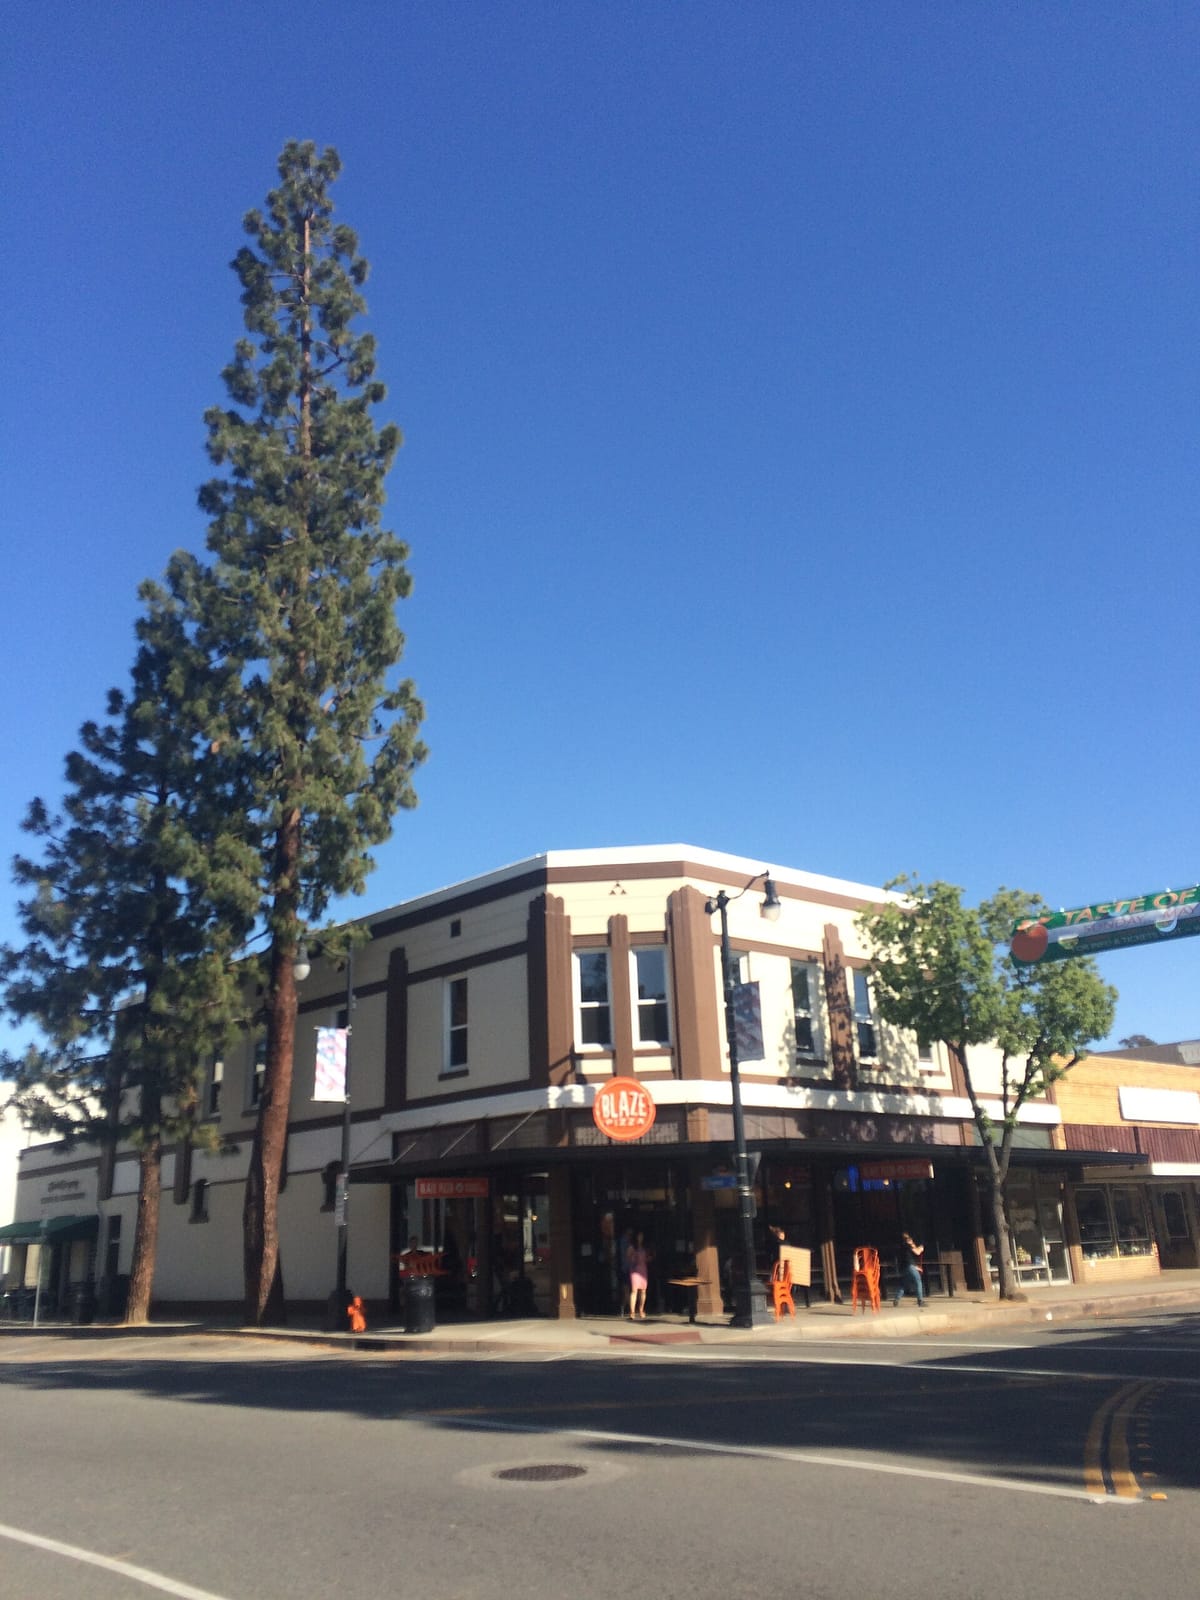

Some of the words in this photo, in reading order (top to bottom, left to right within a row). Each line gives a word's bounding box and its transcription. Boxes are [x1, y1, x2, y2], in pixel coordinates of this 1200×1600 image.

[1063, 898, 1147, 926] TASTE
[1153, 888, 1198, 909] OF
[602, 1090, 647, 1118] BLAZE
[605, 1117, 645, 1127] PIZZA
